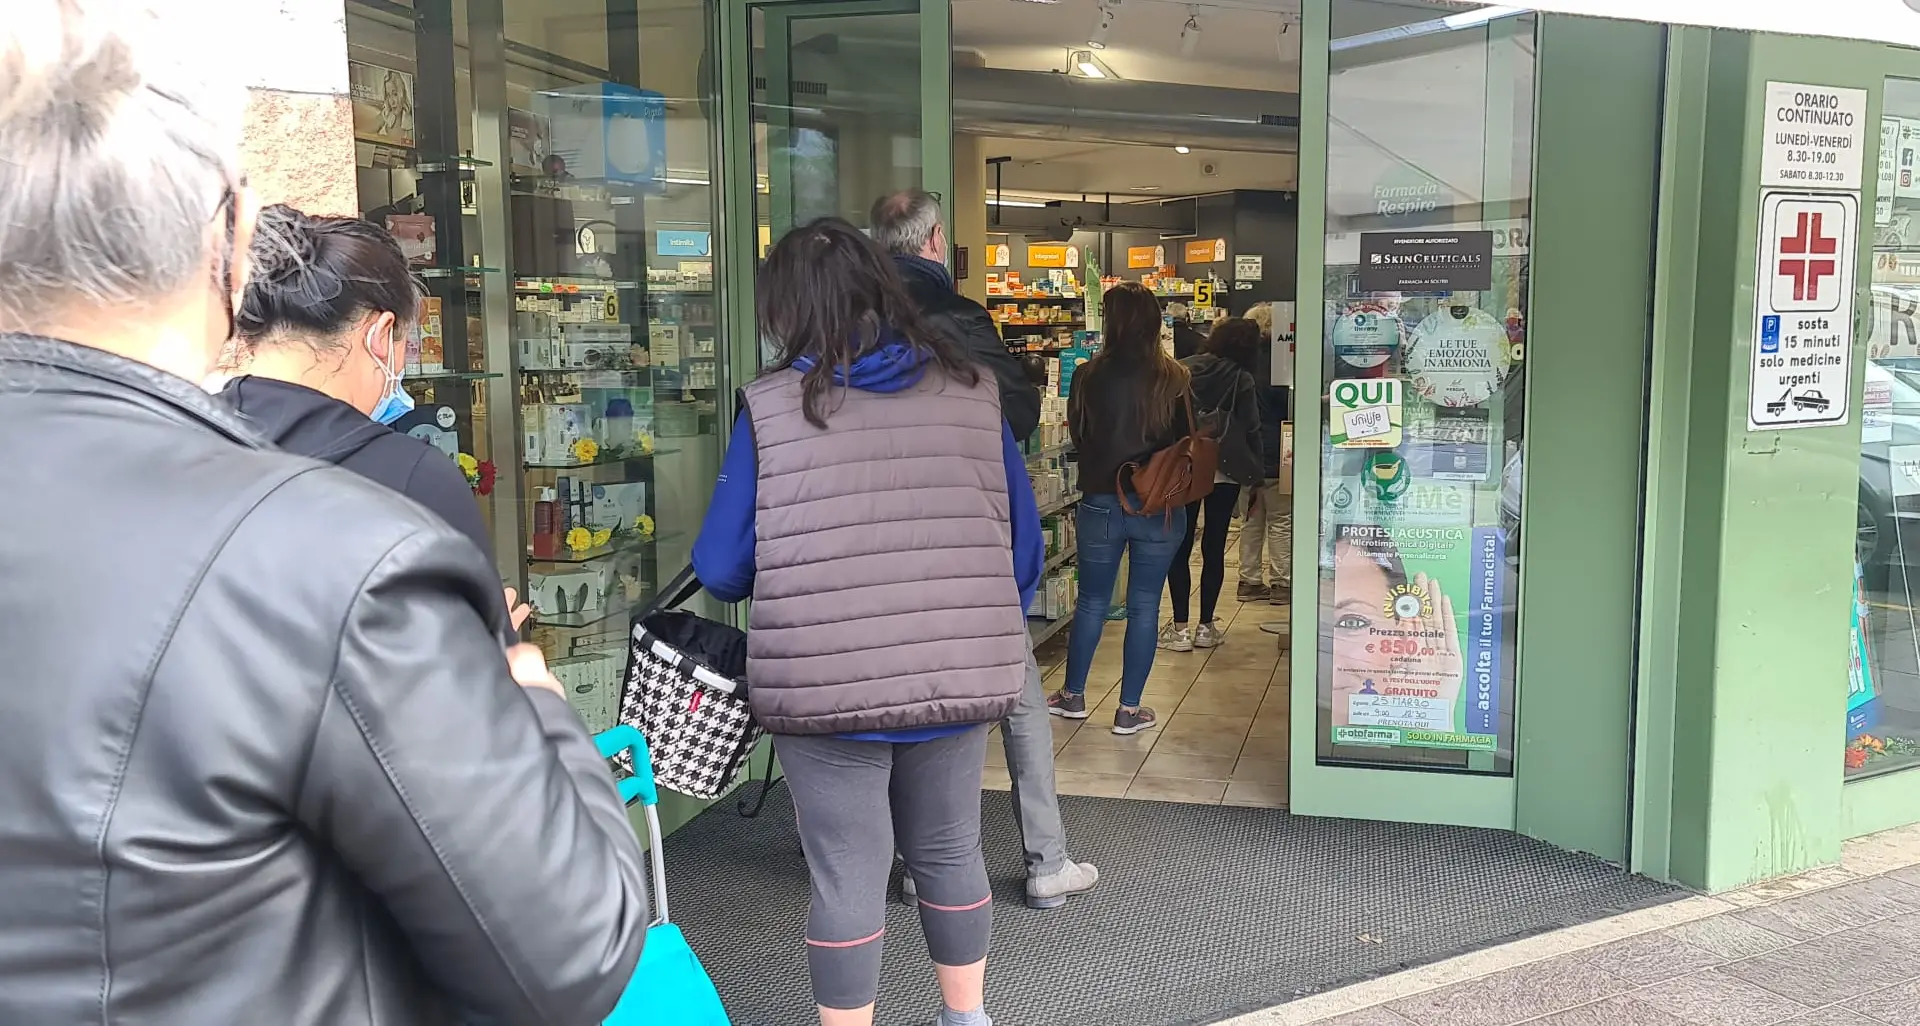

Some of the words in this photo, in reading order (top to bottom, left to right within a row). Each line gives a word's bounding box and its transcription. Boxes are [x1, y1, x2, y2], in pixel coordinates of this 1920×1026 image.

[1794, 91, 1839, 110] ORARIO
[1777, 107, 1854, 127] CONTINUATO
[1775, 130, 1853, 149] LUNEDÌ-VENERDÌ
[1787, 149, 1837, 164] 8.30-19.00
[1779, 169, 1807, 180] SABATO
[1808, 171, 1845, 181] 8.30-12.30
[1374, 181, 1438, 199] Farmacia
[1377, 198, 1437, 217] Respiro
[1197, 285, 1209, 303] 5
[606, 295, 616, 316] 6
[1797, 316, 1829, 330] sosta
[1440, 340, 1452, 348] LE
[1455, 340, 1477, 349] TUE
[1784, 335, 1798, 349] 15
[1803, 334, 1841, 348] minuti
[1429, 349, 1487, 358] EMOZIONI
[1760, 354, 1785, 368] solo
[1790, 353, 1842, 367] medicine
[1424, 359, 1436, 367] IN
[1437, 359, 1491, 368] ARMONIA
[1779, 371, 1821, 387] urgenti
[1335, 382, 1393, 408] QUI
[1342, 527, 1395, 538] PROTESI
[1398, 529, 1463, 540] ACUSTICA
[1350, 539, 1418, 549] Microtimpanica
[1420, 542, 1455, 550] Digitale
[1356, 551, 1393, 559] Altamente
[1395, 553, 1447, 561] Personalizzata
[1480, 535, 1496, 610] Farmacista!
[1481, 611, 1492, 634] tuo
[1369, 627, 1405, 637] Prezzo
[1407, 630, 1445, 639] sociale
[1479, 635, 1492, 648] il
[1384, 687, 1438, 698] GRATUITO
[1371, 696, 1389, 706] 25
[1414, 721, 1429, 729] QUI
[1347, 729, 1393, 739] otofarma
[1407, 731, 1431, 741] SOLO
[1433, 733, 1443, 742] IN
[1444, 734, 1492, 745] FARMACIA
